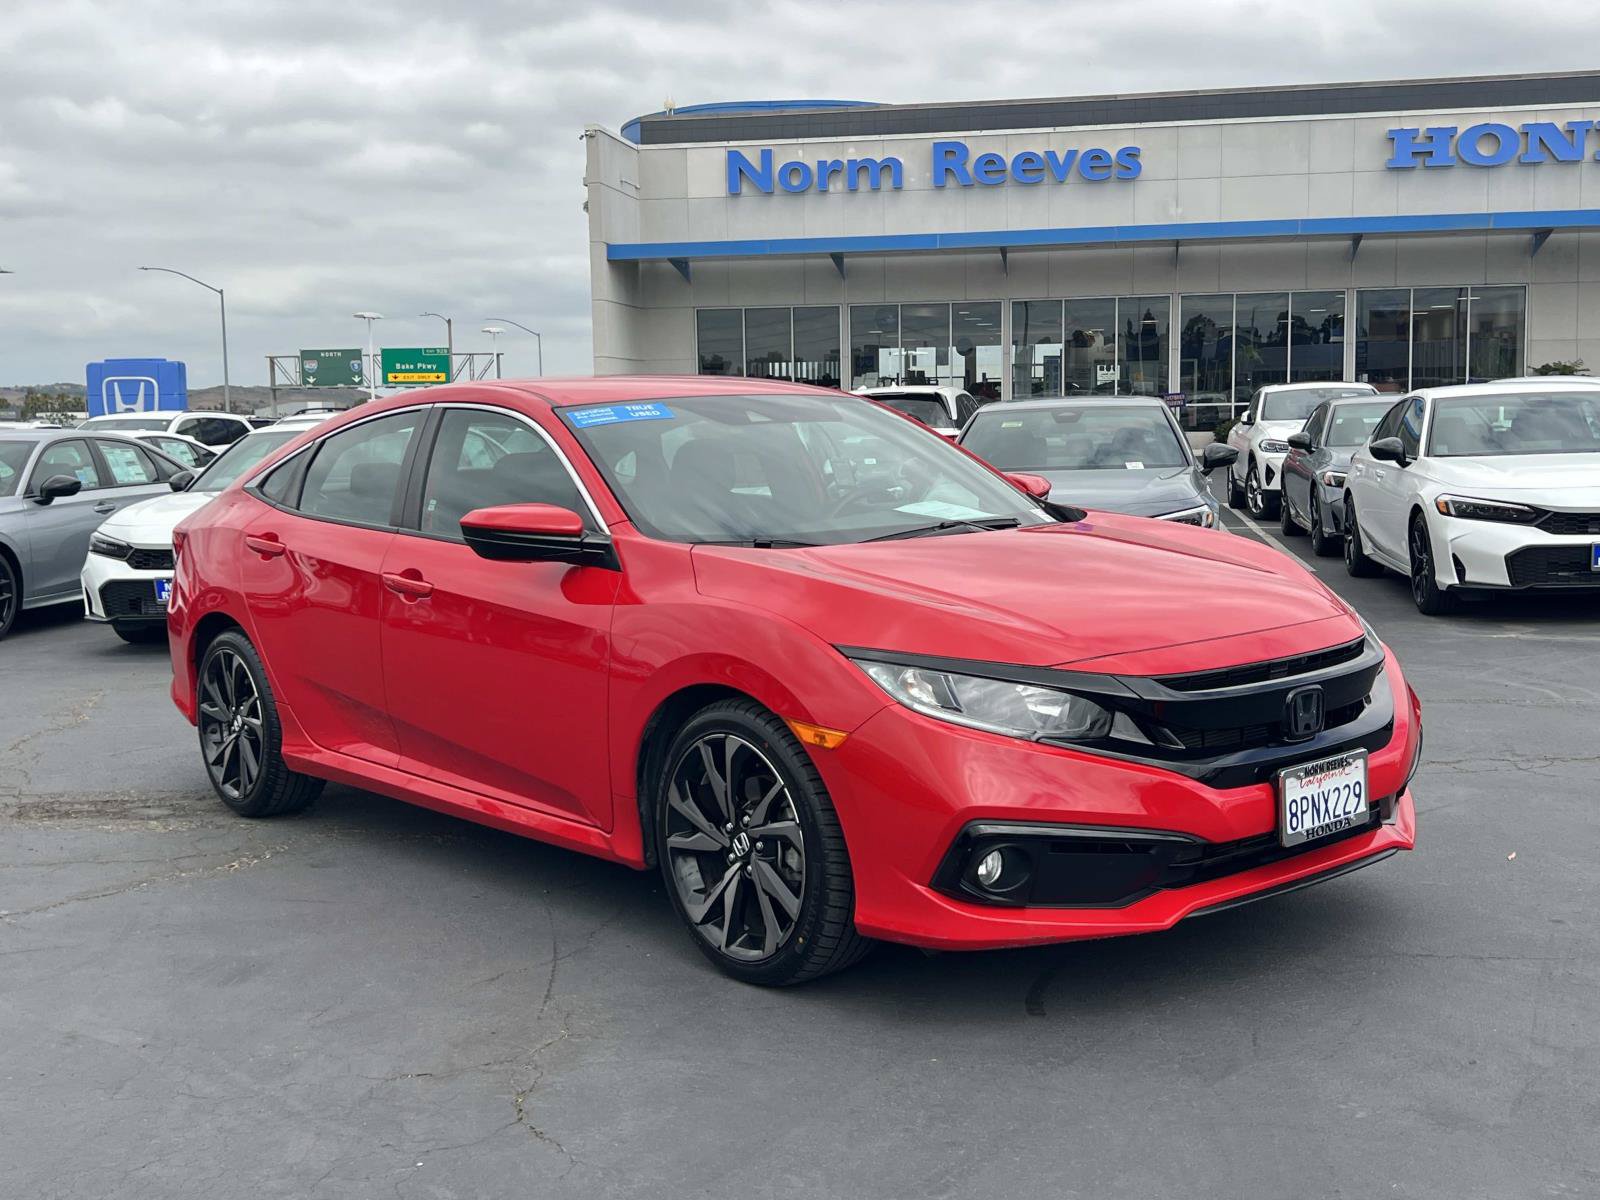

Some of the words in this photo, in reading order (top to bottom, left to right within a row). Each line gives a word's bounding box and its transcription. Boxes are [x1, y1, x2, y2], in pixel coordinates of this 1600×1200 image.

[1386, 120, 1600, 168] HON
[727, 149, 904, 194] Norm
[932, 141, 1143, 187] Reeves
[416, 362, 437, 371] Pkwy
[1304, 762, 1325, 777] NORM
[1326, 757, 1348, 771] REEVES
[1288, 780, 1362, 832] 8PNX229
[1305, 818, 1351, 840] HONDA
